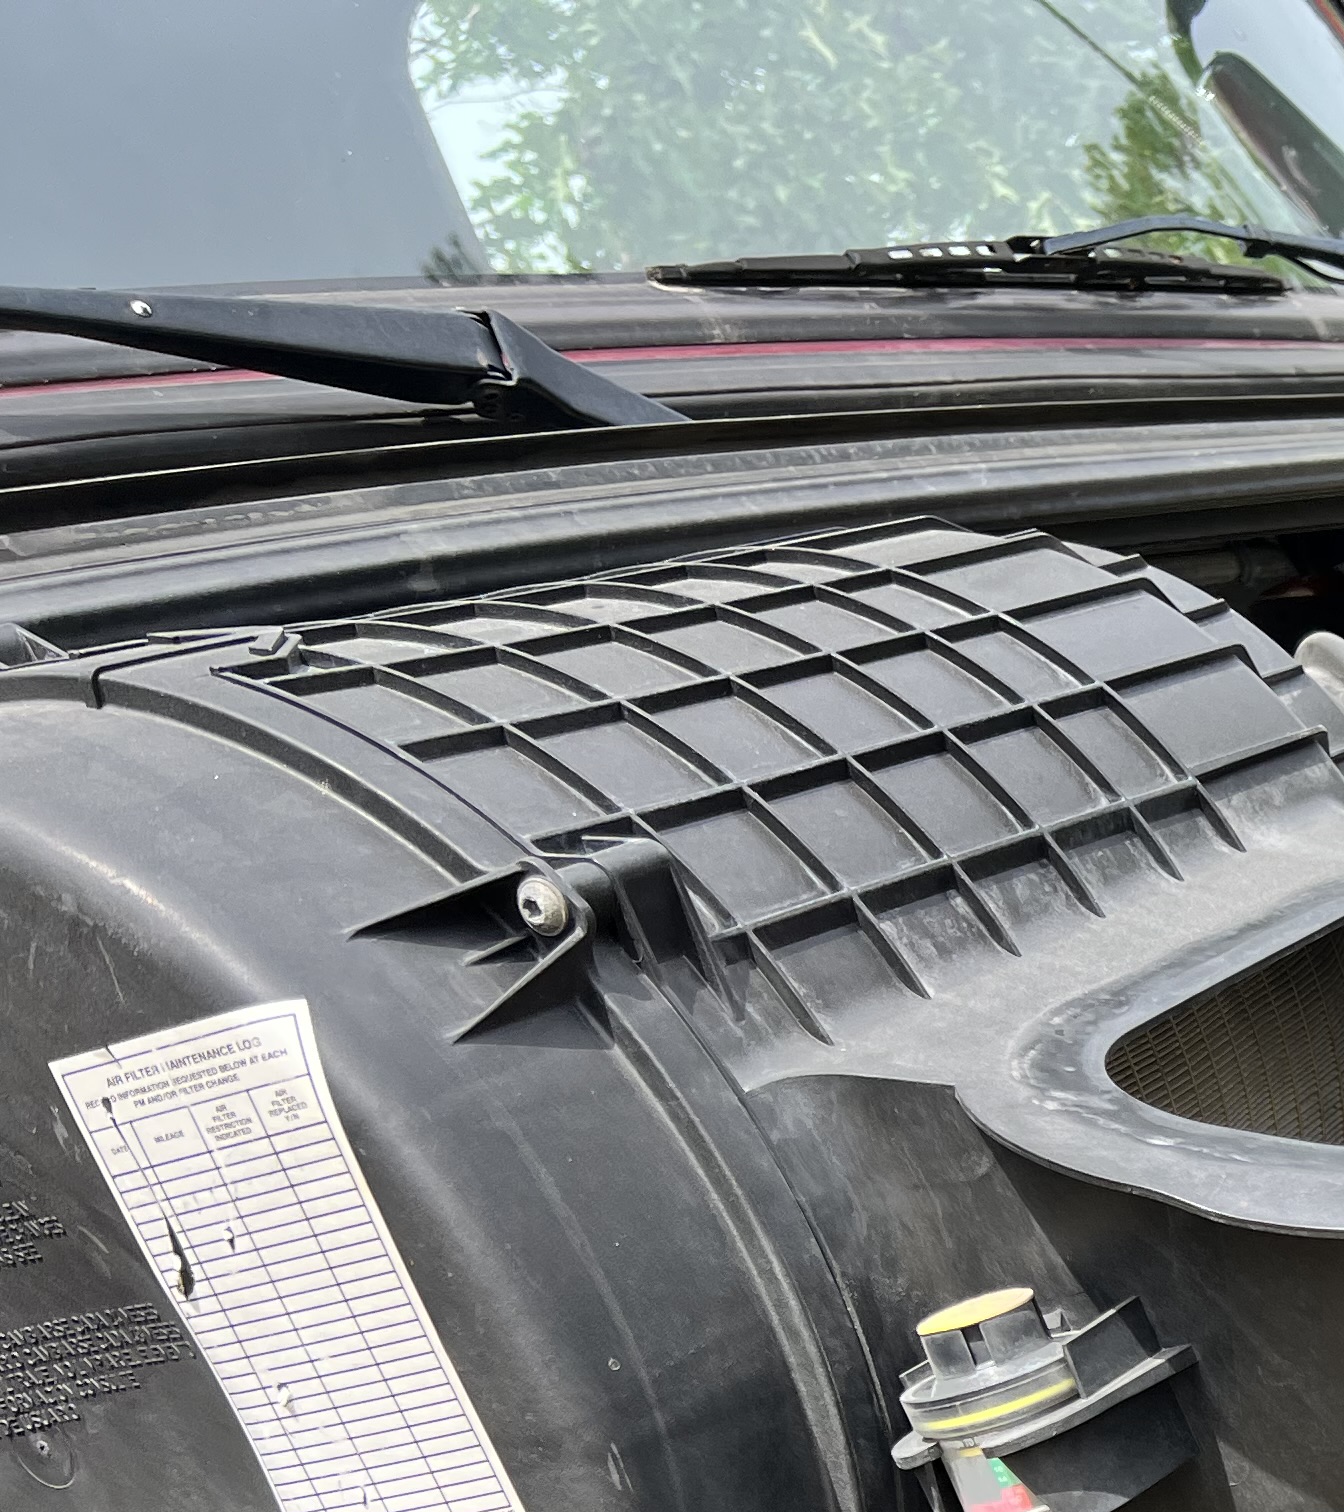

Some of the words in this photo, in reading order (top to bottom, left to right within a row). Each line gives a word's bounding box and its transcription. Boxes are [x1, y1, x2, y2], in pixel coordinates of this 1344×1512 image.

[85, 1094, 117, 1110] RECD
[117, 1080, 170, 1100] INFORMATION
[219, 1059, 248, 1075] BELOW
[250, 1056, 262, 1067] AT
[263, 1048, 288, 1062] EACH
[106, 1075, 122, 1088] AIR
[125, 1065, 160, 1085] FILTER
[236, 1037, 262, 1051] LOG
[134, 1099, 145, 1108] PM
[147, 1091, 177, 1106] AND/OR
[205, 1073, 240, 1089] CHANGE
[212, 1111, 236, 1123] FILTER
